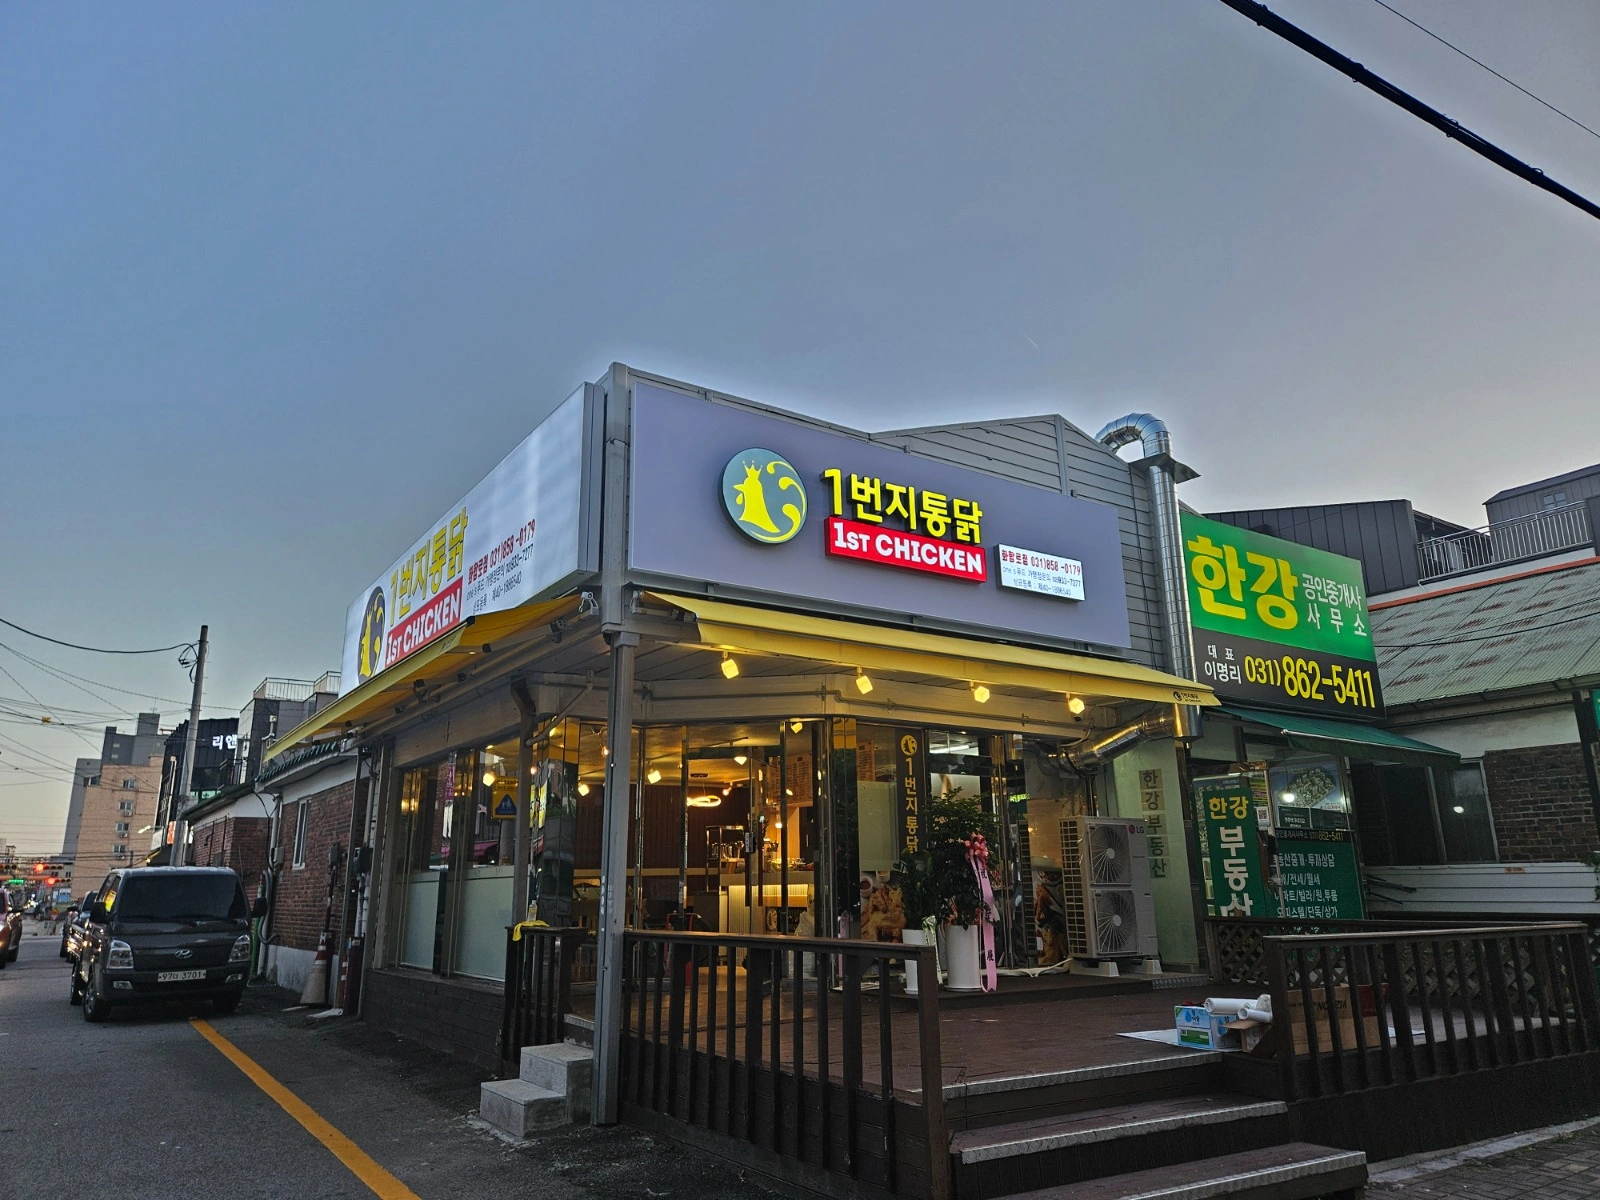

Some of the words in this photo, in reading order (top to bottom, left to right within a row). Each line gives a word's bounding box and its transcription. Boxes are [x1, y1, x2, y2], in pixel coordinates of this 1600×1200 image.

[821, 467, 983, 545] 1번지통닭
[390, 506, 468, 628] 1번지통닭
[833, 521, 871, 552] 1ST
[875, 534, 983, 575] CHICKEN
[1187, 535, 1299, 630] 한강
[1302, 573, 1362, 611] 공인중개사
[386, 635, 403, 665] 1ST
[402, 588, 461, 654] CHICKEN
[1244, 655, 1376, 709] 031)862-5411
[904, 757, 919, 854] 1번지통닭
[1136, 826, 1145, 834] LG
[1209, 796, 1249, 820] 한강
